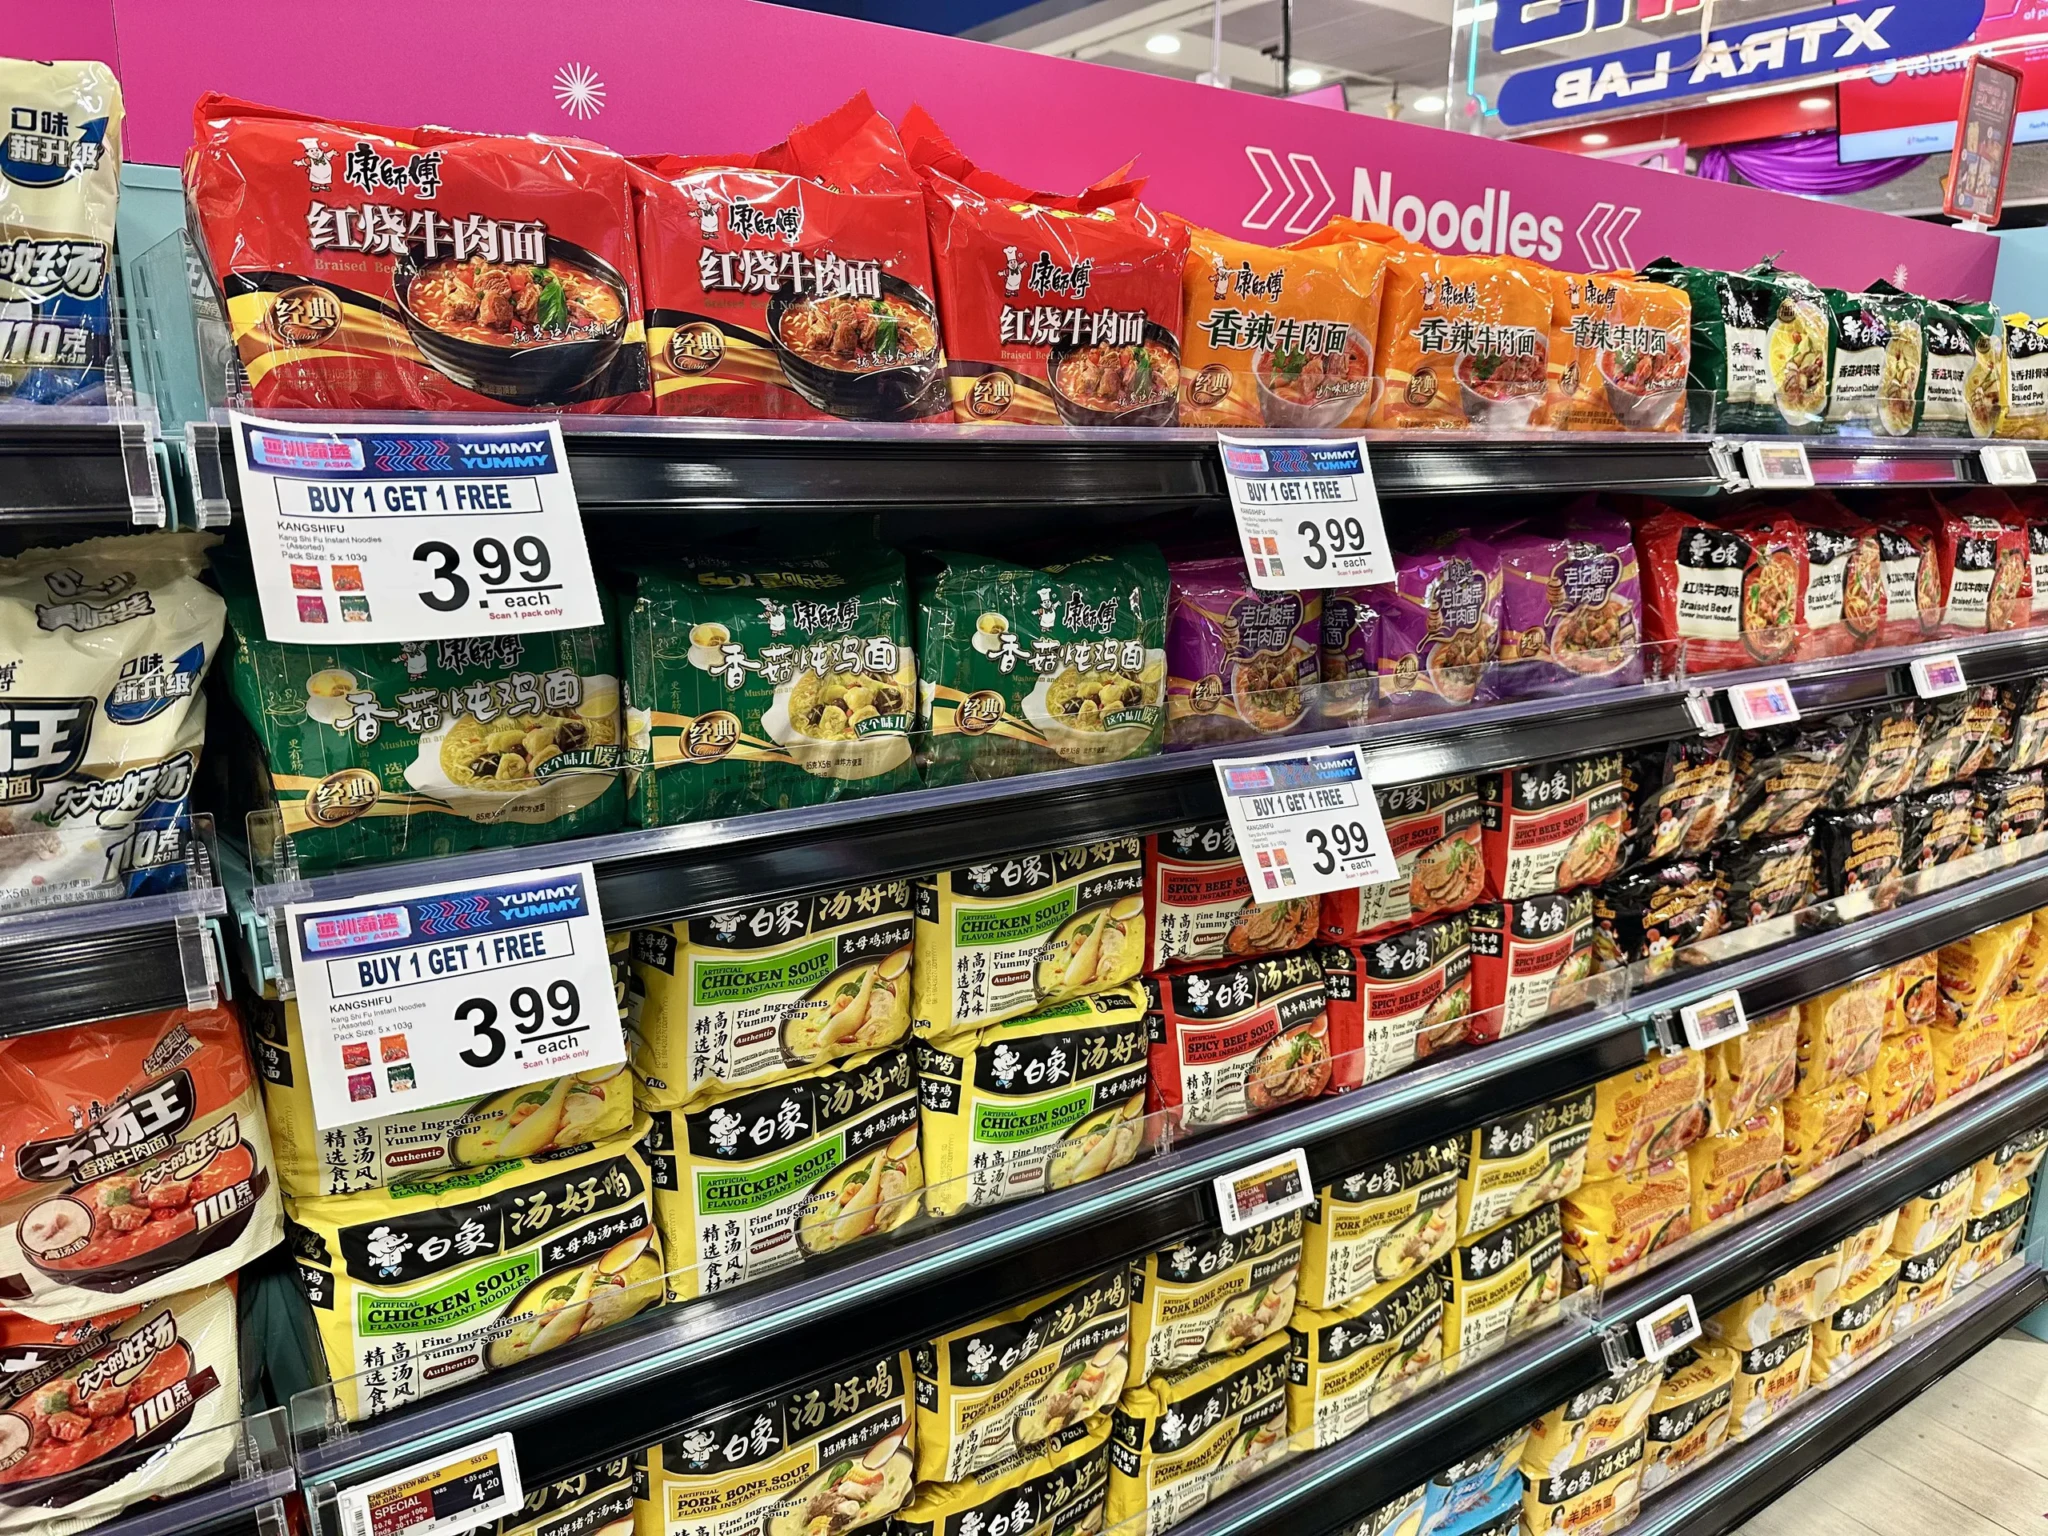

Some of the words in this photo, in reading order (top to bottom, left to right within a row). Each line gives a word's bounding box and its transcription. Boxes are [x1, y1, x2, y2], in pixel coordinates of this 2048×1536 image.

[10, 107, 69, 137] 口味
[9, 133, 100, 169] 新升级
[1352, 166, 1564, 262] Noodles
[305, 201, 548, 266] 红烧牛肉面
[315, 258, 367, 272] Braised
[698, 247, 883, 300] 红烧牛肉面
[274, 296, 338, 328] 经典
[999, 305, 1147, 347] 红烧牛肉面
[672, 332, 721, 357] 经典
[1197, 307, 1350, 357] 香辣牛肉面
[1409, 317, 1538, 357] 香辣牛肉面
[1560, 315, 1667, 354] 香辣牛肉面
[1001, 350, 1032, 360] Braised
[1036, 352, 1054, 360] Beef
[973, 381, 1012, 403] 经典
[1195, 372, 1230, 393] 经典
[266, 455, 298, 466] BEST
[302, 459, 319, 468] OF
[323, 460, 353, 468] ASIA
[458, 441, 545, 455] YUMMY
[460, 455, 548, 469] YUMMY
[1311, 450, 1356, 460] YUMMY
[307, 486, 354, 513] BUY
[364, 486, 376, 512] 1
[384, 486, 428, 511] GET
[437, 486, 448, 510] 1
[455, 484, 512, 509] FREE
[1246, 483, 1268, 501] BUY
[1271, 483, 1278, 501] 1
[1280, 482, 1301, 500] GET
[1305, 482, 1312, 500] 1
[1313, 481, 1341, 499] FREE
[277, 521, 345, 534] KANGSHIFU
[279, 534, 298, 543] Kang
[1298, 517, 1365, 570] 3.99
[282, 551, 303, 560] Pack
[305, 552, 327, 561] Size:
[329, 553, 335, 561] 5
[345, 553, 367, 563] 103g
[286, 543, 325, 551] (Assorted)
[1344, 557, 1366, 568] each
[412, 535, 551, 612] 3.99
[1564, 564, 1614, 588] 老坛酸菜
[505, 592, 551, 608] each
[1440, 583, 1483, 608] 老坛酸菜
[1568, 584, 1605, 603] 牛肉面
[1680, 600, 1707, 613] Braised
[1709, 603, 1732, 613] Beef
[489, 612, 512, 620] Scan
[522, 610, 543, 619] pack
[544, 608, 564, 618] only
[1240, 604, 1296, 627] 老坛酸菜
[1444, 606, 1481, 627] 牛肉面
[1243, 626, 1287, 648] 牛肉面
[119, 653, 164, 680] 口味
[709, 635, 900, 690] 香菇炖鸡面
[986, 633, 1146, 675] 香菇炖鸡面
[113, 672, 191, 704] 新升级
[335, 667, 584, 745] 香菇炖鸡面
[964, 698, 1000, 720] 经典
[689, 719, 737, 746] 经典
[1313, 758, 1354, 770] YUMMY
[53, 753, 192, 815] 大大的好汤
[315, 777, 377, 810] 经典
[1253, 797, 1275, 816] BUY
[1278, 795, 1285, 813] 1
[1286, 793, 1307, 812] GET
[1309, 791, 1316, 808] 1
[1317, 788, 1344, 806] FREE
[1306, 822, 1369, 875] 3.99
[497, 885, 578, 907] YUMMY
[961, 914, 1031, 934] CHICKEN
[1035, 899, 1070, 920] SOUP
[358, 955, 404, 987] BUY
[410, 952, 421, 978] 1
[428, 944, 469, 975] GET
[476, 941, 488, 966] 1
[495, 931, 546, 963] FREE
[329, 995, 392, 1014] KANGSHIFU
[454, 979, 580, 1068] 3.99
[1188, 1041, 1220, 1053] SPICY
[1223, 1032, 1248, 1047] BEEF
[1251, 1020, 1275, 1038] SOUP
[819, 1053, 912, 1118] 汤好喝
[748, 1097, 809, 1146] 白象
[851, 1106, 917, 1146] 老母鸡汤味面
[78, 1133, 169, 1180] 香辣牛肉面
[141, 1113, 239, 1192] 大大的好汤
[510, 1164, 632, 1235] 汤好喝
[749, 1213, 773, 1226] Fine
[776, 1190, 836, 1217] Ingredients
[749, 1216, 791, 1237] Yummy
[793, 1204, 819, 1220] Soup
[417, 1217, 494, 1263] 白象
[550, 1215, 644, 1261] 老母鸡汤味面
[703, 1223, 722, 1293] 精选食材
[368, 1289, 470, 1323] CHICKEN
[477, 1263, 530, 1296] SOUP
[369, 1321, 419, 1331] FLAVOR
[423, 1307, 477, 1326] INSTANT
[480, 1276, 531, 1308] NOODLES
[369, 1301, 420, 1309] ARTIFICIAL
[78, 1310, 176, 1399] 大大的好汤
[426, 1356, 477, 1377] Authentic
[790, 1361, 893, 1431] 汤好喝
[722, 1413, 780, 1462] 白象
[822, 1414, 901, 1458] 招牌猪骨汤味面
[369, 1486, 397, 1501] CHICKEN
[398, 1480, 417, 1492] STEW
[417, 1475, 431, 1485] NDL
[382, 1492, 403, 1505] XIANG
[472, 1477, 500, 1501] 4.20
[677, 1494, 721, 1512] PORK
[726, 1478, 767, 1500] BONE
[772, 1463, 811, 1485] SOUP
[374, 1496, 422, 1520] SPECIAL
